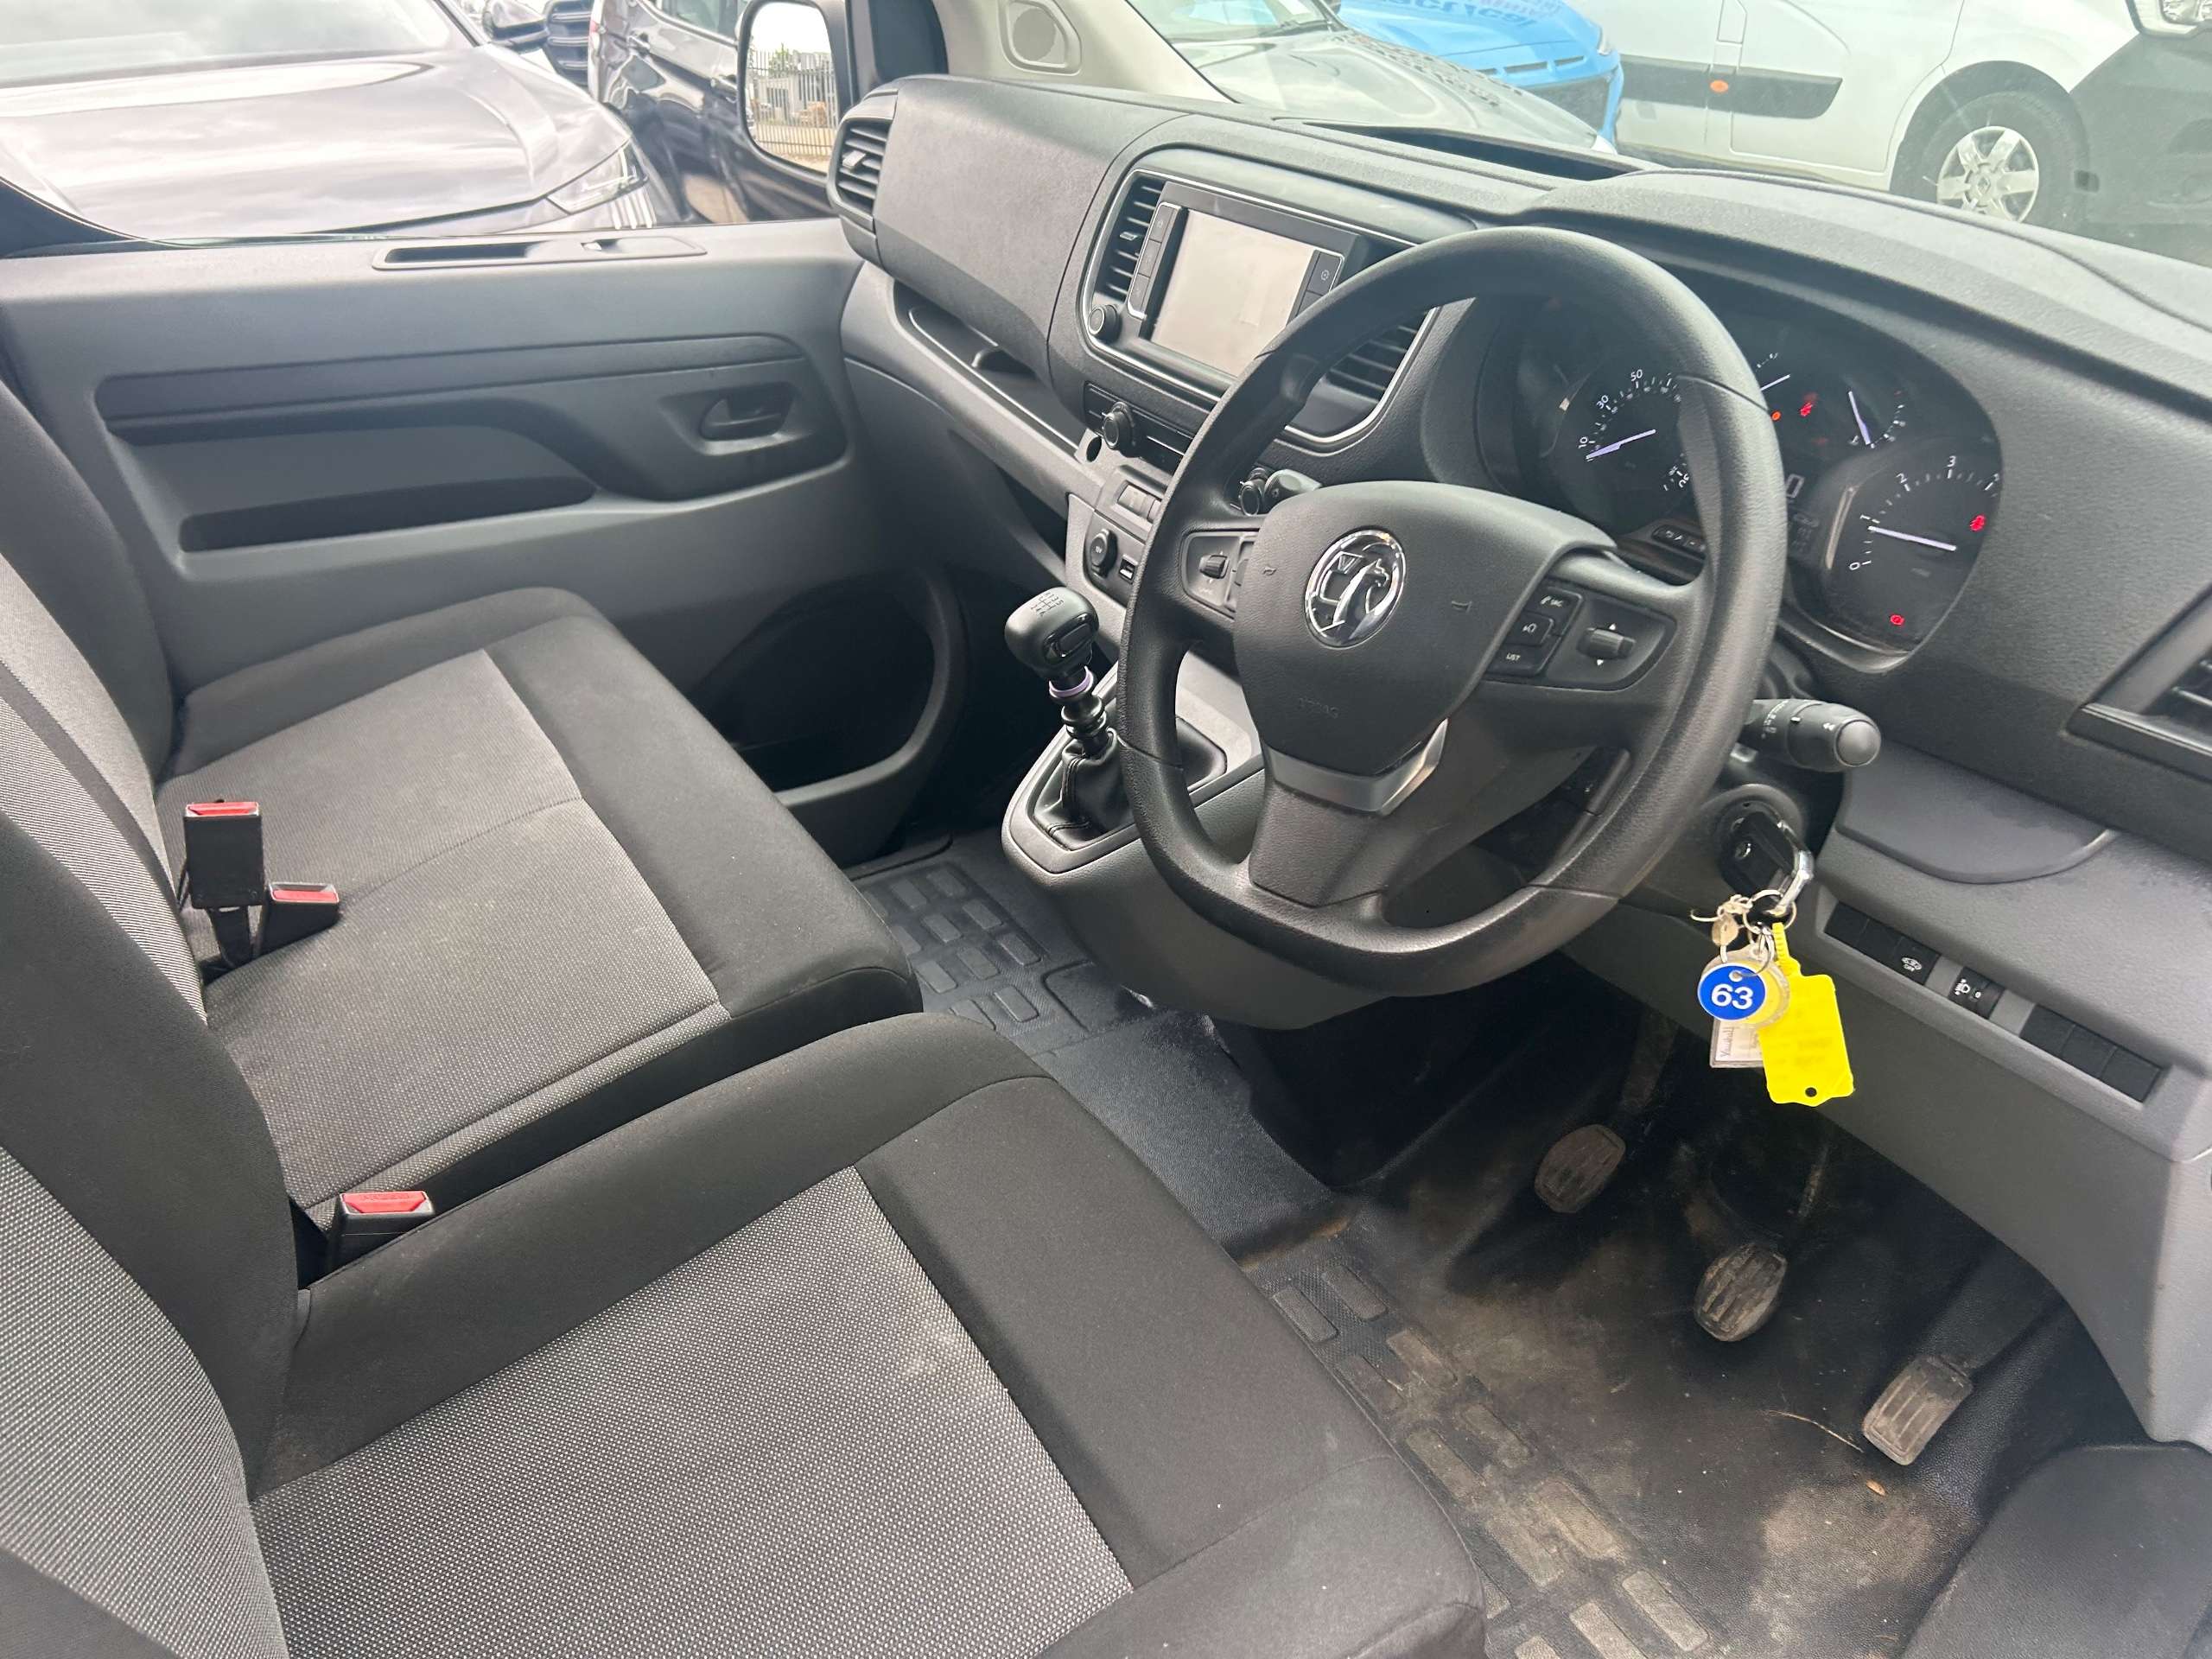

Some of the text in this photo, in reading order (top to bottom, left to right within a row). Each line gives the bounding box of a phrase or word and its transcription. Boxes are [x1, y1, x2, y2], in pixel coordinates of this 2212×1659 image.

[1630, 369, 1643, 382] 50
[1597, 395, 1610, 410] 30
[1578, 436, 1589, 449] 10
[1947, 455, 1956, 467] 3
[1896, 473, 1907, 484] 2
[1848, 561, 1861, 571] 0
[1711, 983, 1754, 1010] 63
